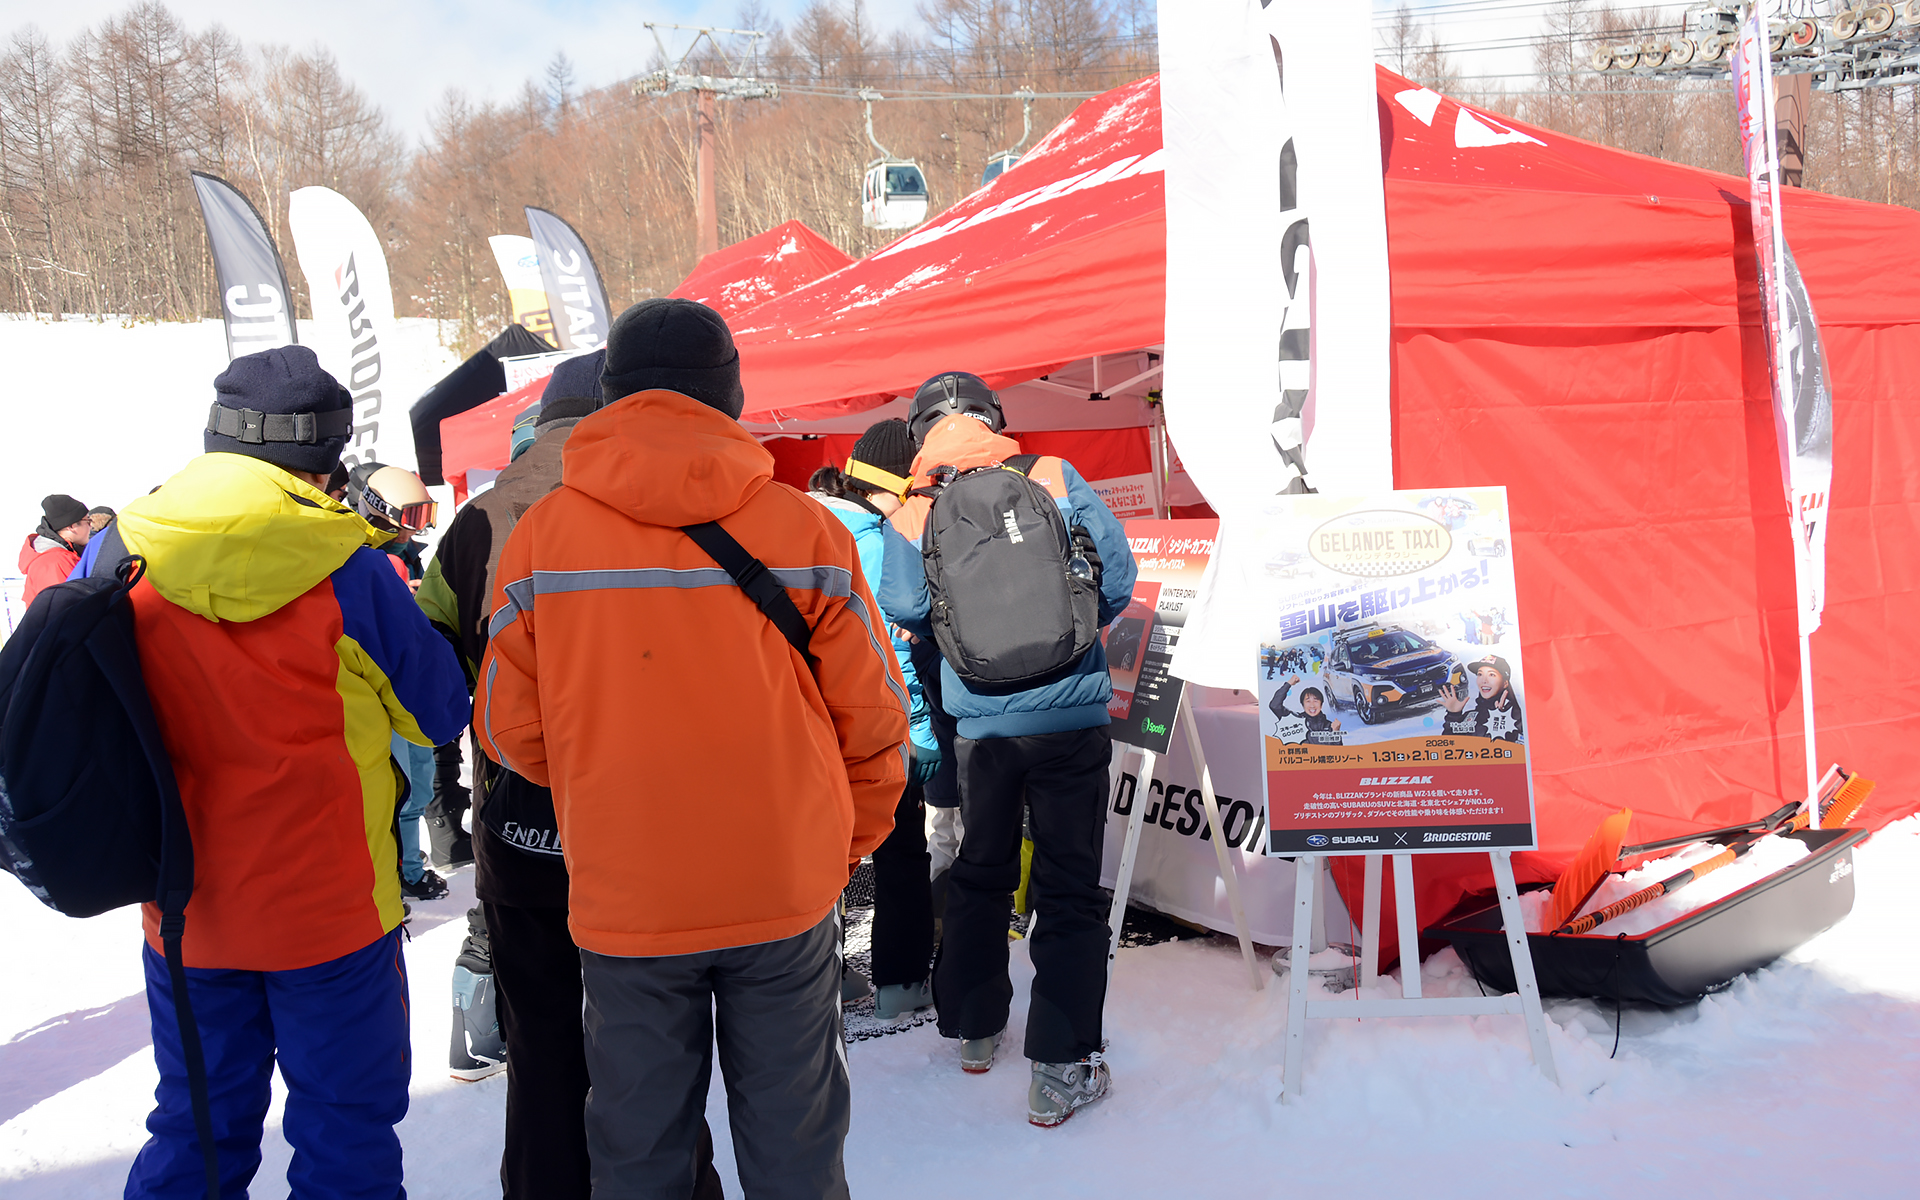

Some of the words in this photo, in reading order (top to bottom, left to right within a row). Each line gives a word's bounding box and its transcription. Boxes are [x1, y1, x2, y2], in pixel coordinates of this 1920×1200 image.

[1003, 509, 1024, 544] THULE
[1320, 531, 1394, 552] GELANDE
[1402, 529, 1440, 549] TAXI
[1162, 588, 1183, 599] WINTER
[1279, 559, 1490, 641] 雪山を駆け上がる!
[1158, 600, 1183, 612] PLAYLIST
[1149, 722, 1167, 736] Spotify
[1425, 739, 1455, 747] 2026年
[1279, 754, 1364, 764] バルコール嬬恋リゾート
[1359, 775, 1434, 786] BLIZZAK
[1331, 835, 1379, 845] SUBARU
[1422, 831, 1493, 843] BRIDGESTONE
